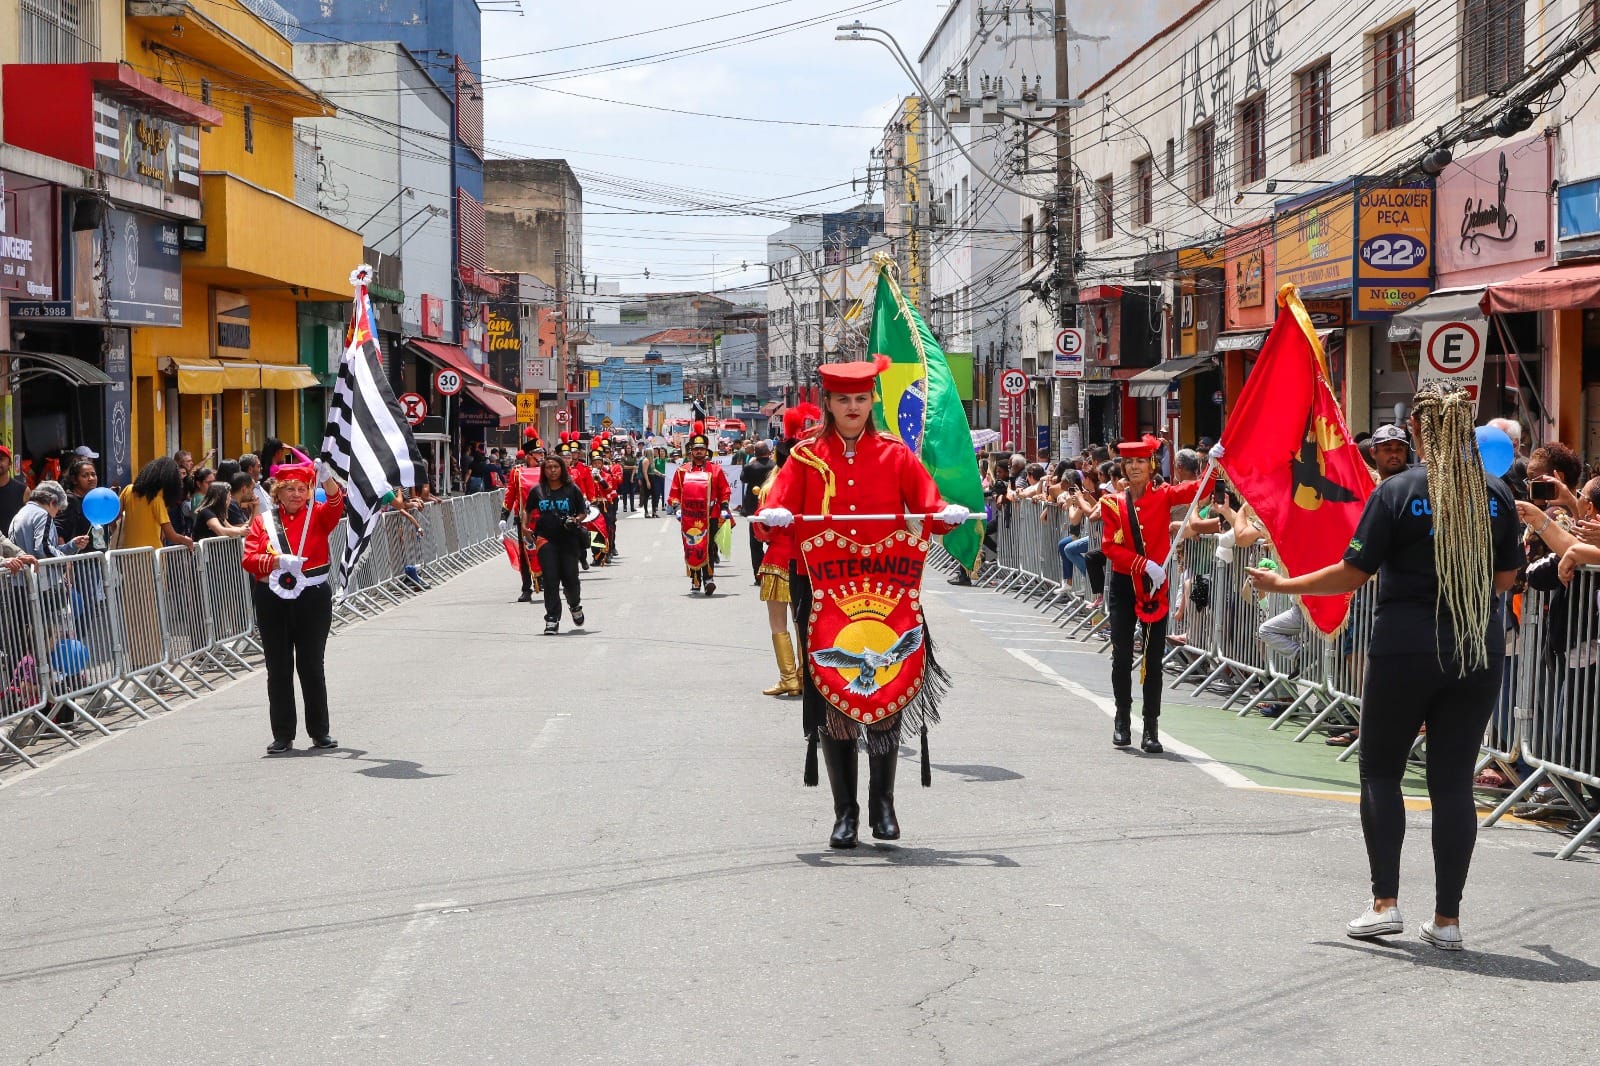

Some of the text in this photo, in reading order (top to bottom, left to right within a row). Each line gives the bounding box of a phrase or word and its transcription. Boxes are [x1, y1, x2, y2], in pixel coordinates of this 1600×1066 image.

[1360, 193, 1428, 208] QUALQUER
[1377, 210, 1410, 227] PEÇA
[1370, 288, 1416, 300] Núcleo
[44, 307, 66, 316] 3988
[487, 331, 521, 351] Tom
[1063, 334, 1074, 351] E
[1443, 333, 1464, 363] E
[440, 374, 458, 386] 30
[1006, 376, 1023, 388] 30
[808, 554, 924, 582] VETERANOS
